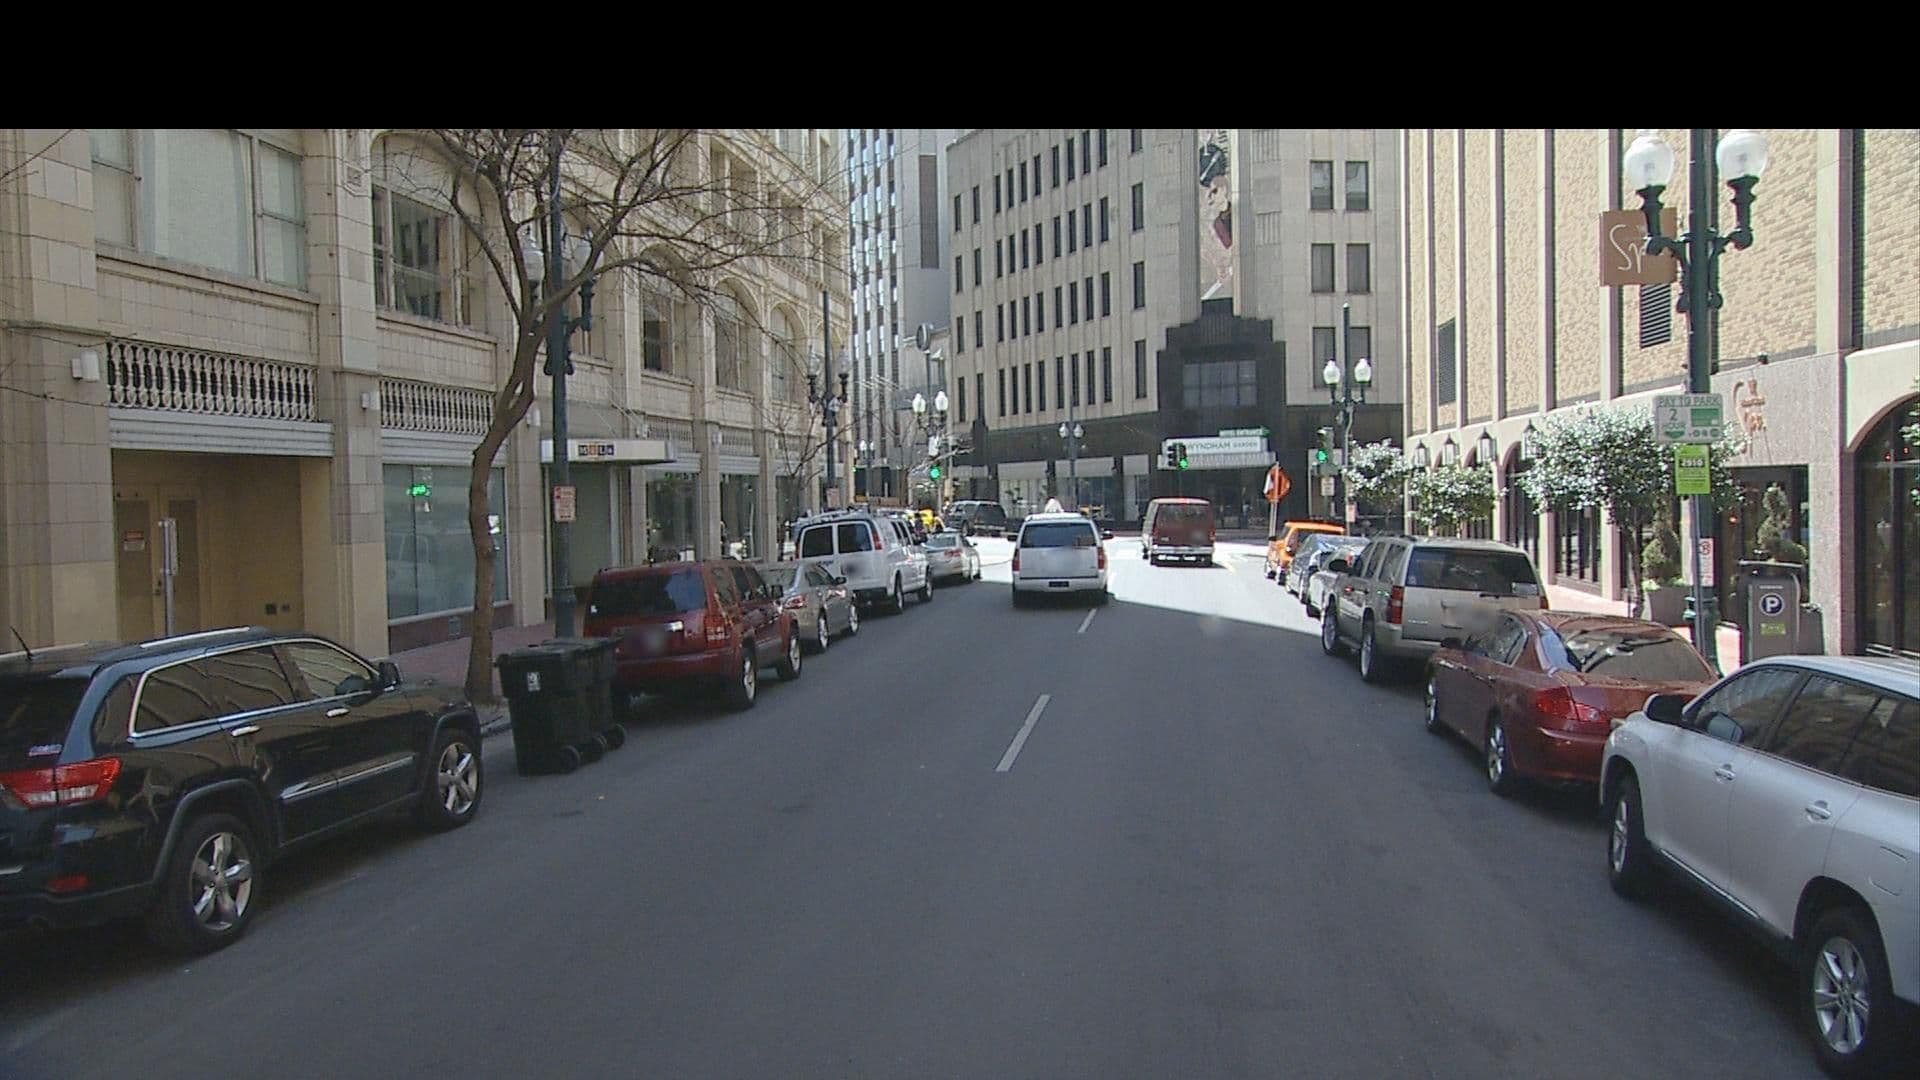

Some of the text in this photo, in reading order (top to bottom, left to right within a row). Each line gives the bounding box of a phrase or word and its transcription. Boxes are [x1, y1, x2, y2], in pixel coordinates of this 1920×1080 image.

[1659, 395, 1720, 407] PAY TO PARK
[1668, 408, 1678, 421] 2
[1187, 441, 1231, 450] WYNDHAM
[1765, 597, 1781, 613] P
